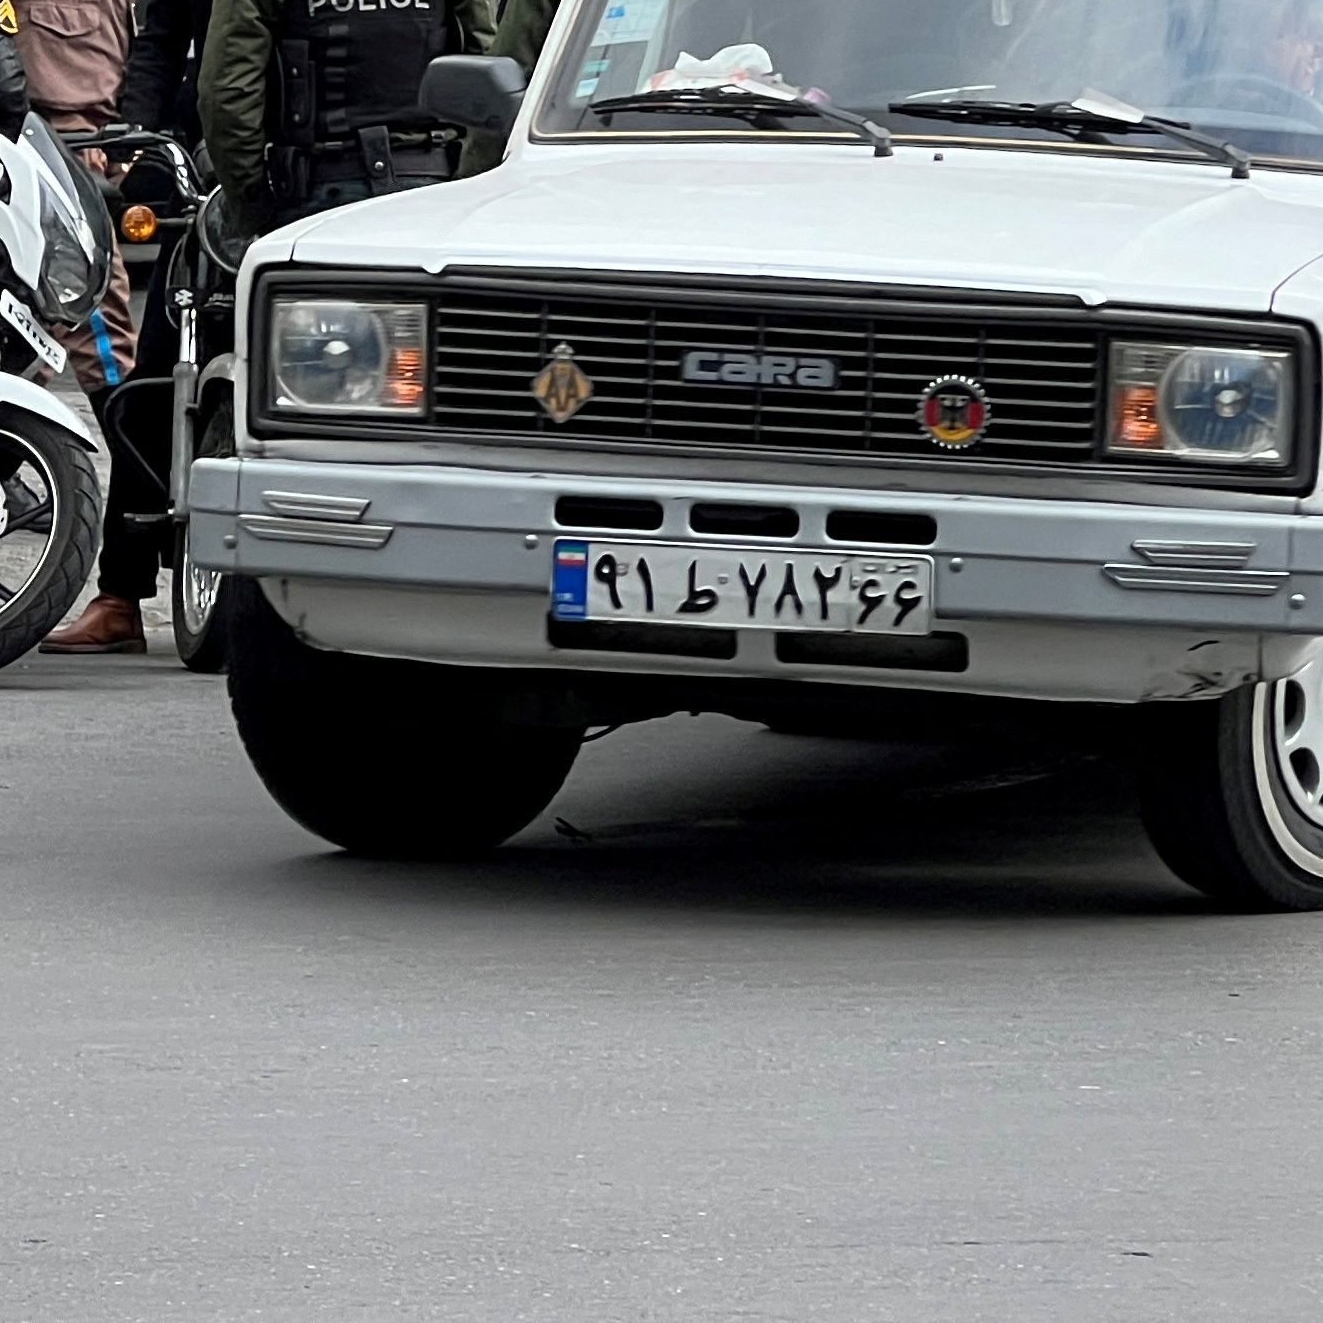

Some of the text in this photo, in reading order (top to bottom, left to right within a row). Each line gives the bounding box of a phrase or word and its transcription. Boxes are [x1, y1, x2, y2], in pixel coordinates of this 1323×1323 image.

[594, 553, 655, 613] ۹۱
[675, 559, 719, 614] ط
[738, 562, 842, 621] ۷۸۲
[857, 579, 924, 627] ۶۶
